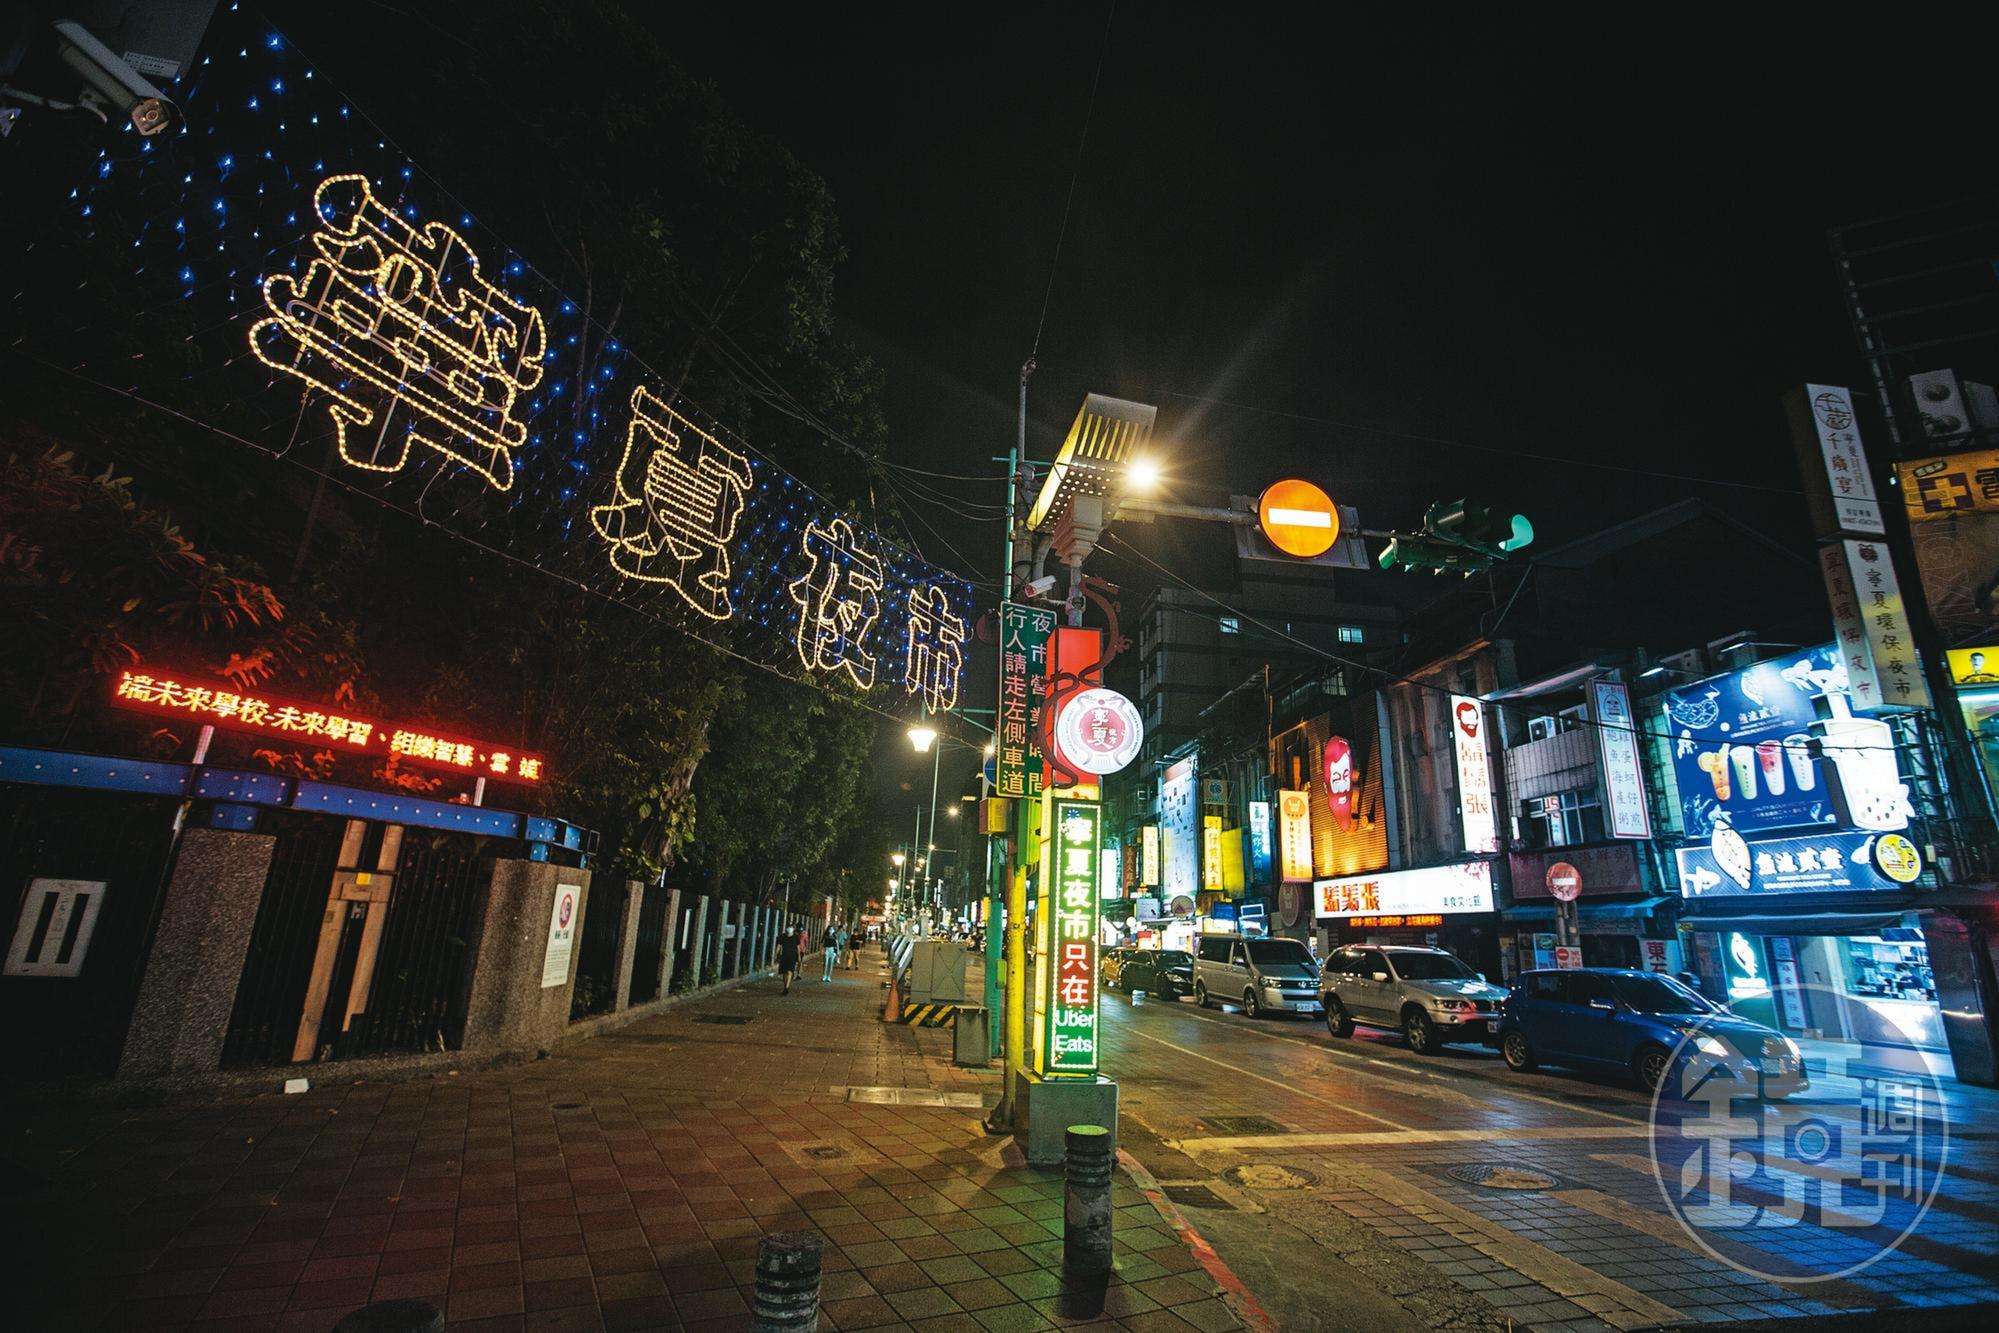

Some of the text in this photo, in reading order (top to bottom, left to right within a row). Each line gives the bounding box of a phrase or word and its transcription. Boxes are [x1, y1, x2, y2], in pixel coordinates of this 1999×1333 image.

[1865, 568, 1912, 699] 寧夏環保夜市
[1002, 606, 1028, 795] 行人請走左側車道
[1060, 817, 1093, 1005] 寧夏夜市只在
[1322, 880, 1381, 913] 鬍鬚張
[1055, 1009, 1095, 1028] Uber
[1055, 1034, 1093, 1053] Eats
